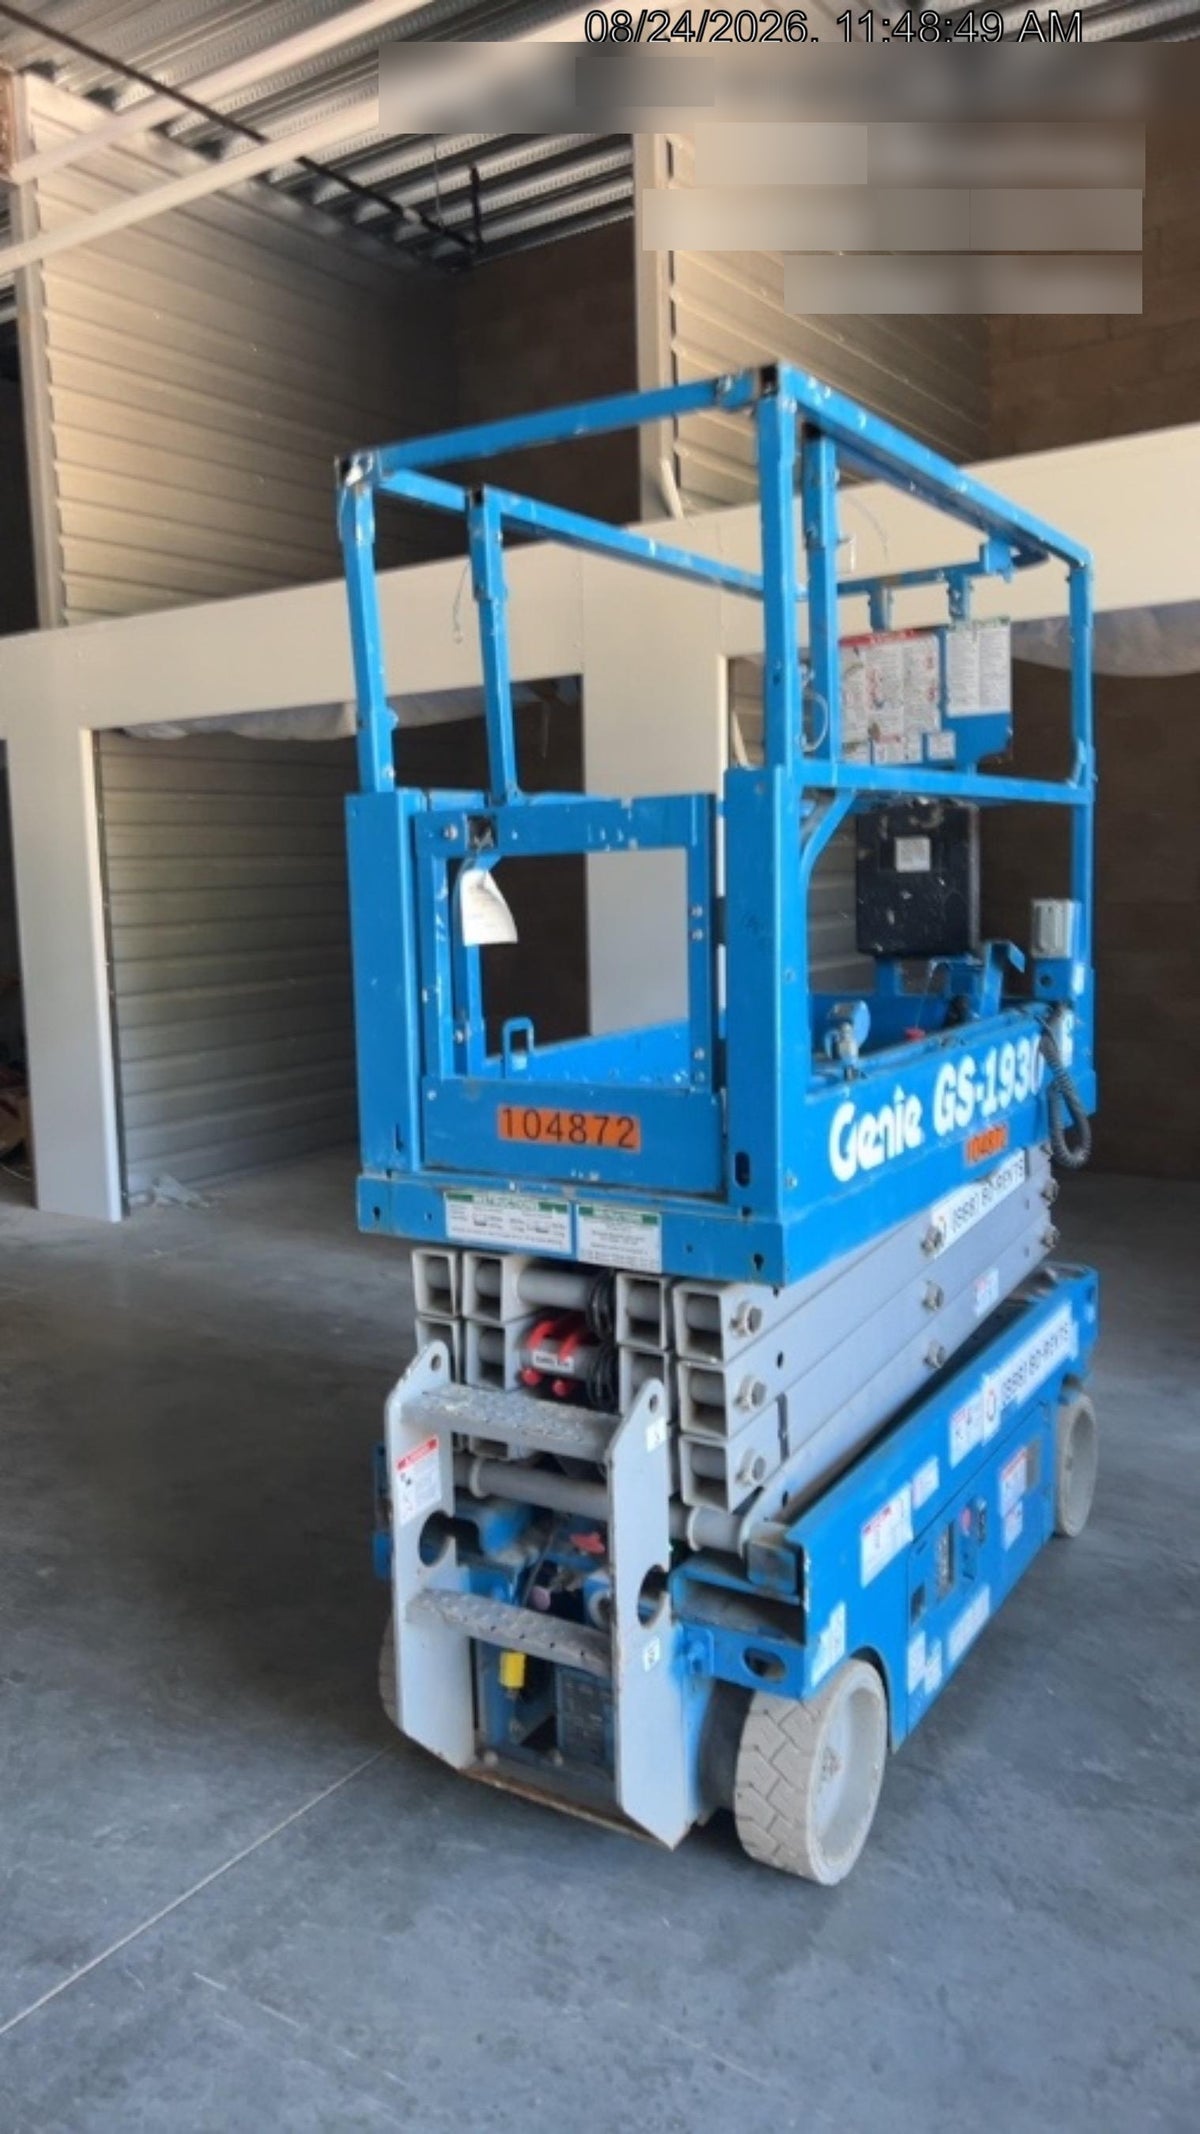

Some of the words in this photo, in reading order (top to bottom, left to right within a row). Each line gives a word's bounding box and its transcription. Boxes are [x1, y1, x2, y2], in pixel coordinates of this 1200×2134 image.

[502, 1106, 635, 1149] 104872
[829, 1084, 924, 1182] Genie
[933, 1033, 1045, 1136] GS-1930
